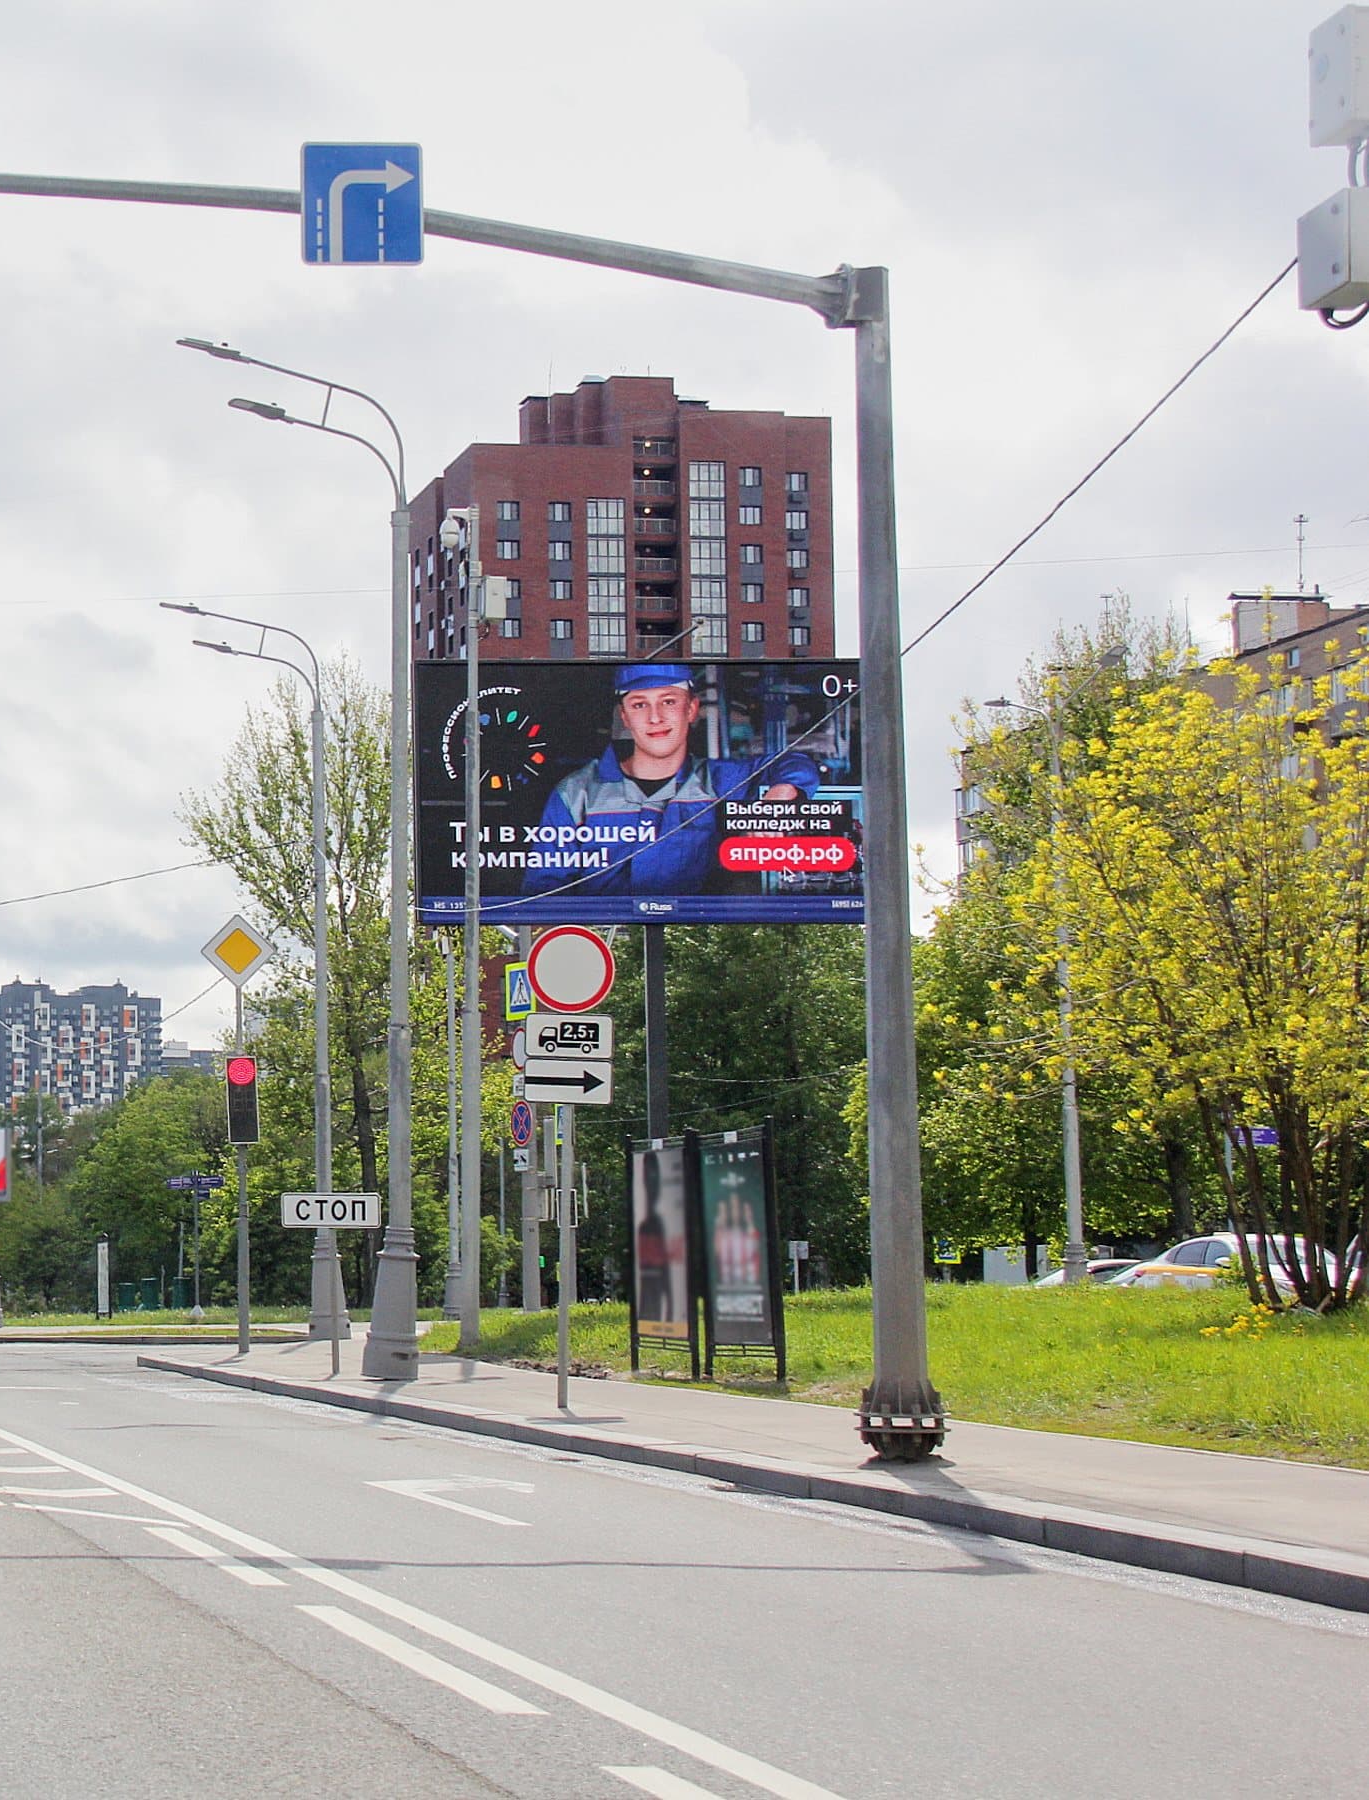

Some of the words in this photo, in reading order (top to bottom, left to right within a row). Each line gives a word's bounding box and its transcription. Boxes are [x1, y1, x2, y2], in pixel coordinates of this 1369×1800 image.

[822, 674, 858, 697] 0+
[726, 802, 795, 817] Выбери
[800, 801, 842, 815] свой
[499, 826, 516, 843] в
[523, 821, 656, 848] хорошей
[726, 819, 806, 831] колледж
[810, 819, 831, 830] на
[729, 844, 844, 864] япроф.рф
[295, 1199, 366, 1221] СТОП
